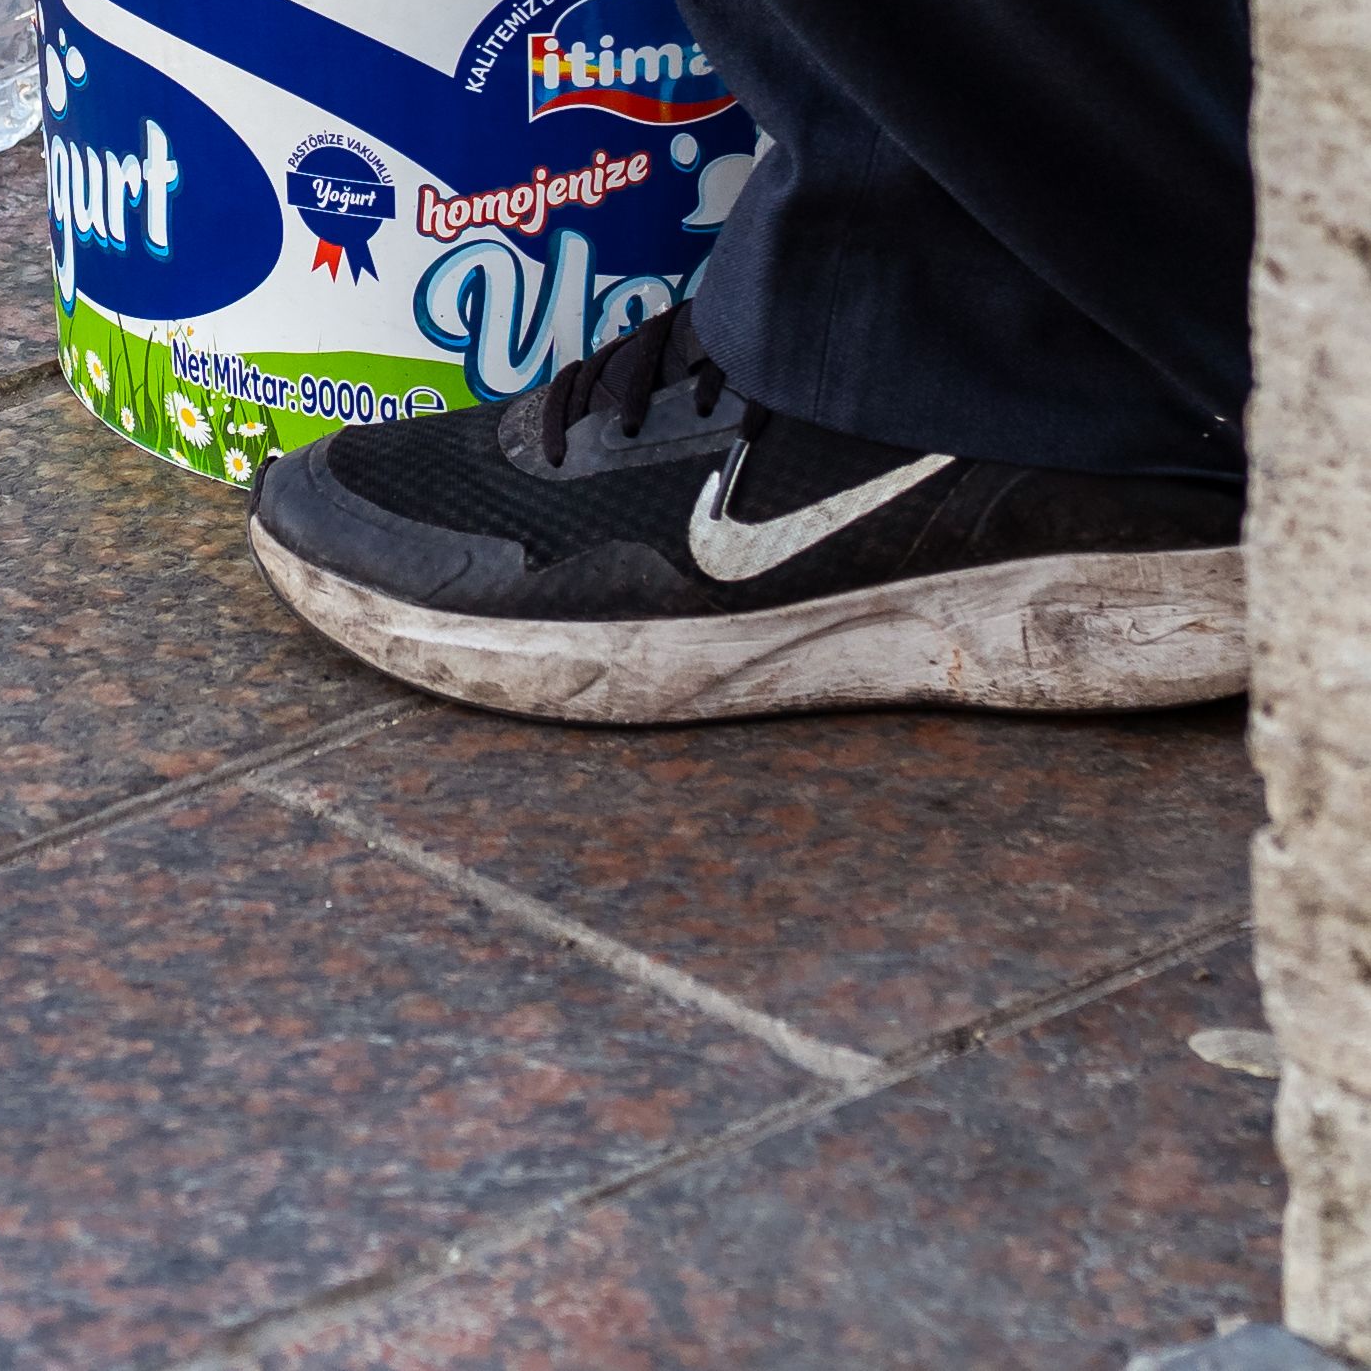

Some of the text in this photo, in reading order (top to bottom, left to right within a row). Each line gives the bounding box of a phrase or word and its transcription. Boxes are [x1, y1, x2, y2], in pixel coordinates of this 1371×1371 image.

[287, 129, 394, 185] PASTÖRİZE VAKUMLU
[312, 178, 377, 213] Yoğurt
[419, 150, 651, 237] homojenize
[172, 338, 210, 388] Net
[213, 353, 297, 411] Miktar:
[300, 375, 374, 423] 9000
